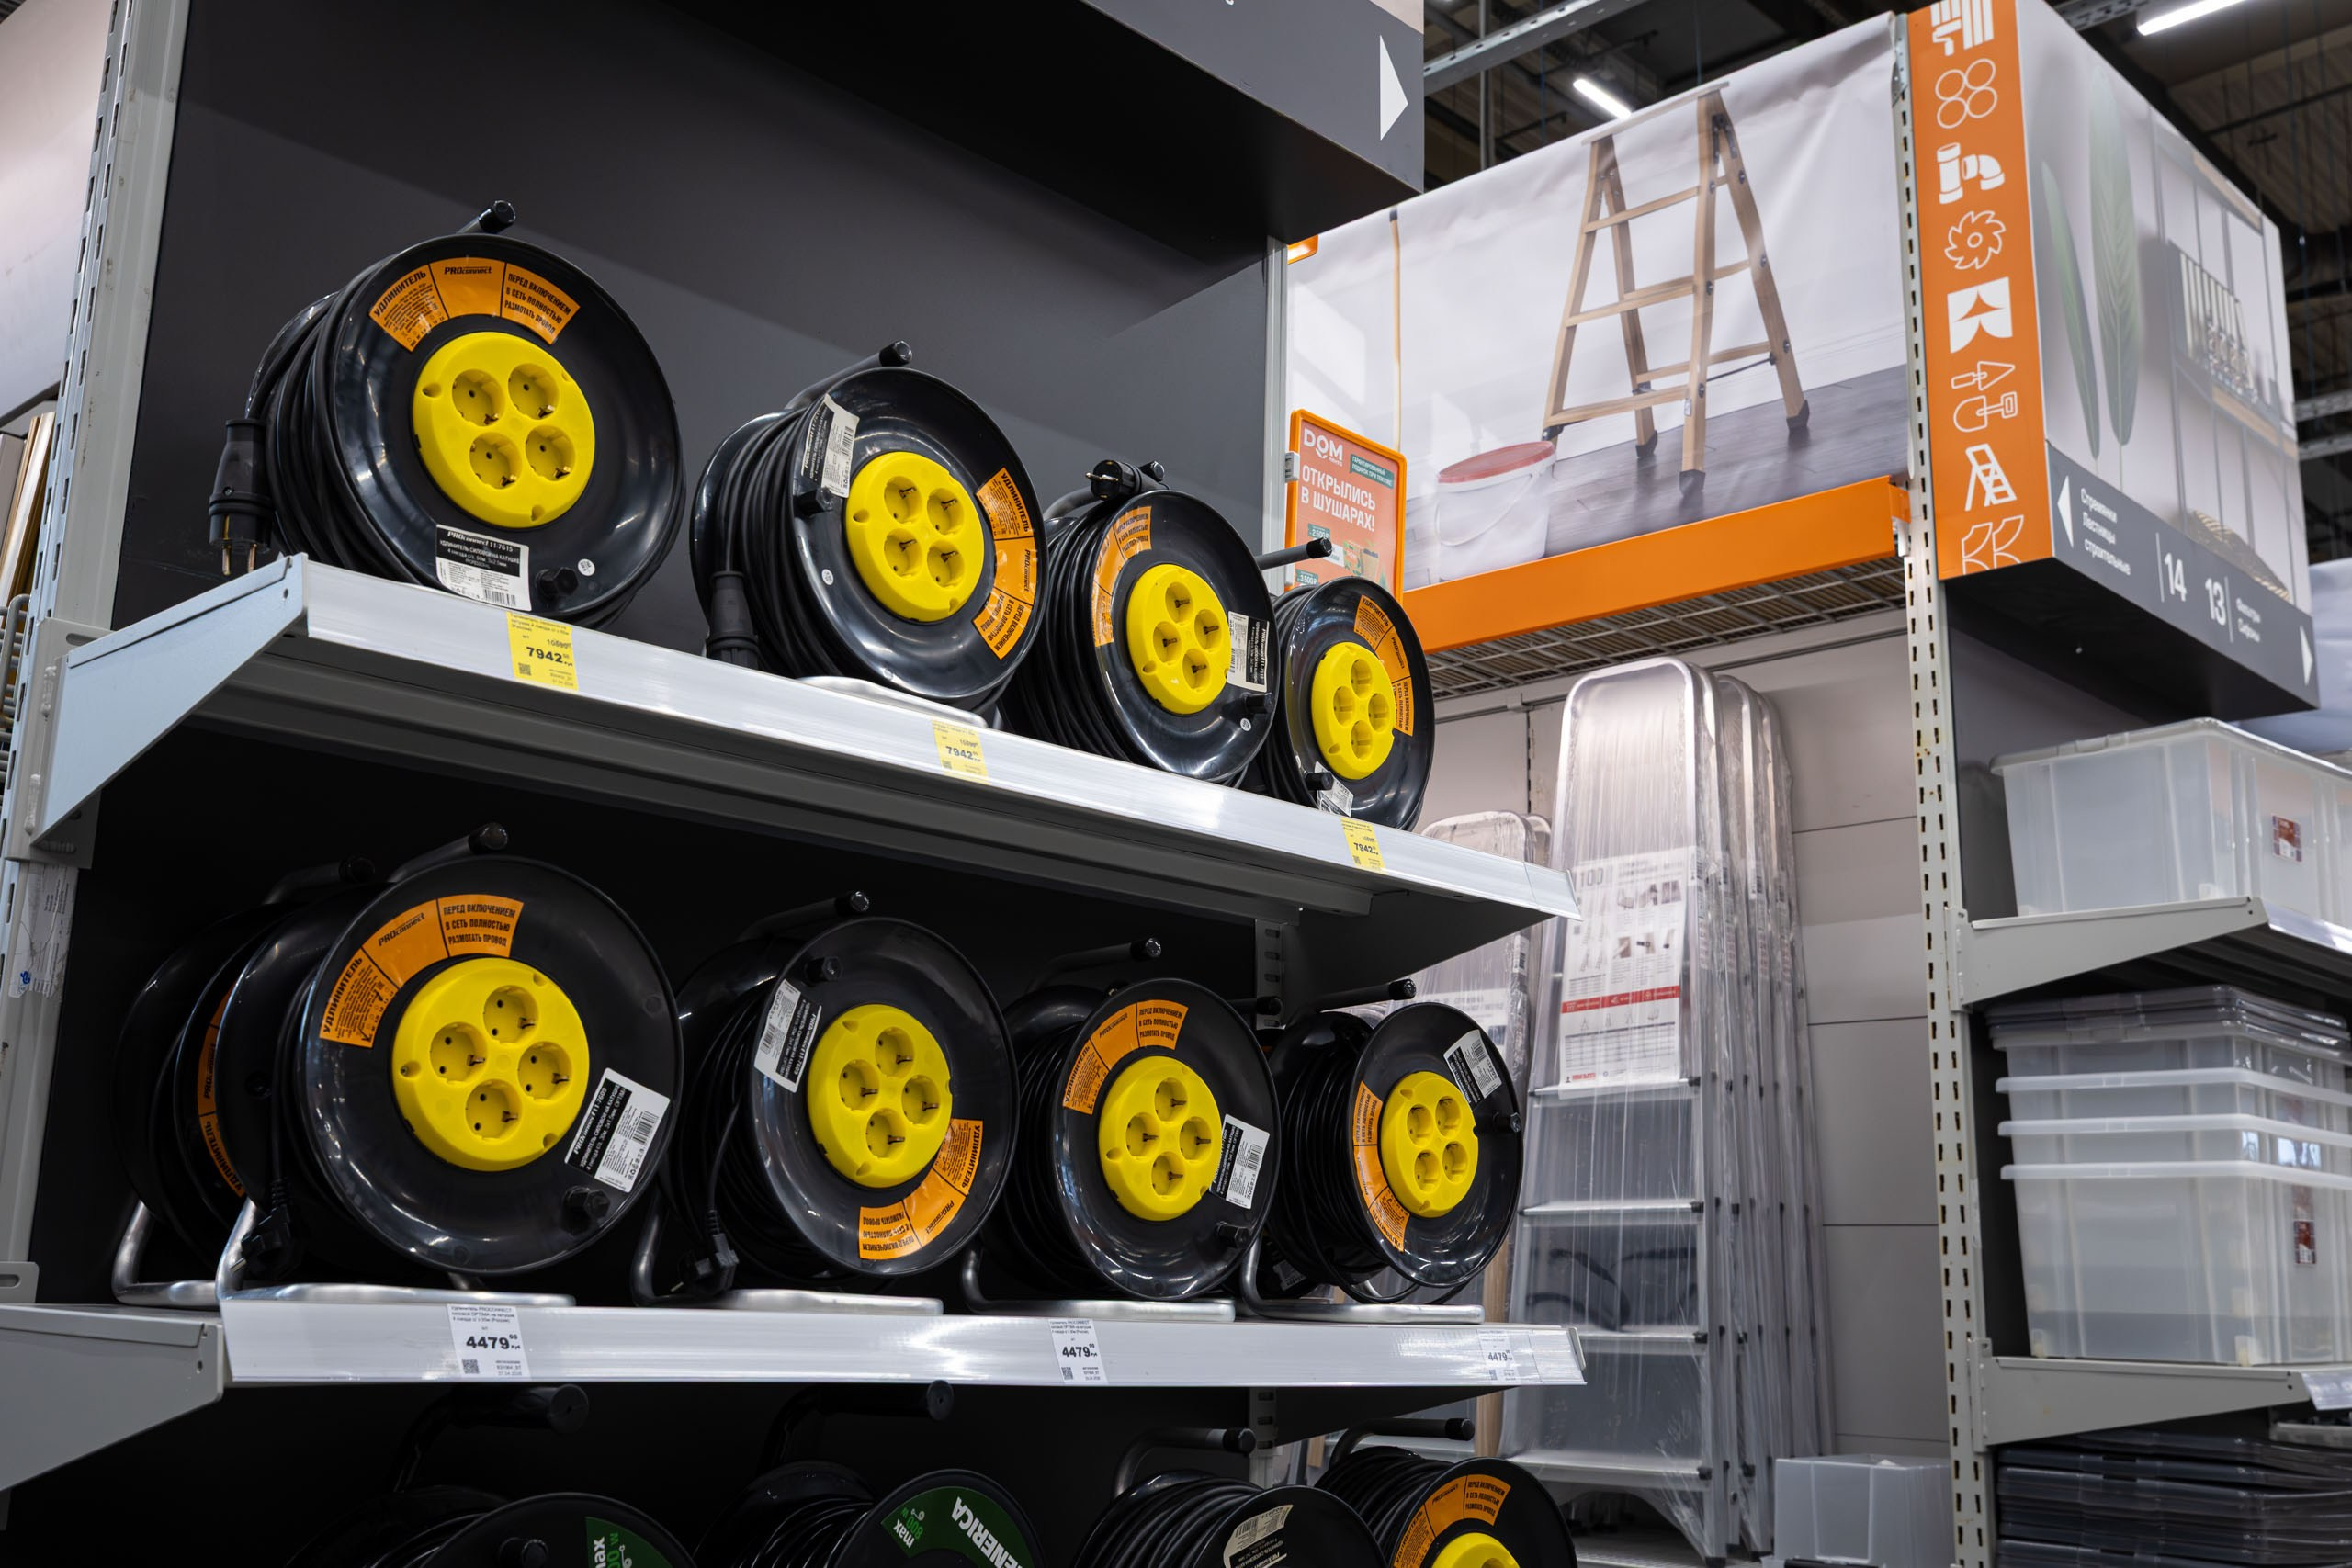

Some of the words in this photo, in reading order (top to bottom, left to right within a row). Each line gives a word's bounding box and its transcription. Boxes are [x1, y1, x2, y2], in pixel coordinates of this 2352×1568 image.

[444, 265, 492, 275] PROconnect
[374, 271, 426, 317] УДЛИНИТЕЛЬ
[508, 273, 528, 289] ПЕРЕД
[528, 281, 571, 316] ВКЛЮЧЕНИЕМ
[511, 288, 526, 301] СЕТЬ
[526, 294, 562, 324] ПОЛНОСТЬЮ
[504, 299, 536, 320] РАЗМОТАТЬ
[536, 311, 556, 334] ПРОВОД
[1001, 473, 1030, 533] УДЛИНИТЕЛЬ
[1302, 465, 1376, 511] ОТКРЫЛИСЬ
[1301, 486, 1310, 504] В
[1313, 491, 1375, 532] ШУШАРАХ!
[2165, 553, 2187, 602] 14
[2205, 577, 2226, 626] 13
[526, 646, 562, 663] 7942
[945, 746, 973, 760] 7942
[1353, 842, 1374, 853] 7942
[443, 904, 465, 915] ПЕРЕД
[467, 903, 516, 918] ВКЛЮЧЕНИЕМ
[451, 920, 468, 929] СЕТЬ
[469, 919, 511, 931] ПОЛНОСТЬЮ
[378, 912, 424, 946] PROconnect
[447, 935, 482, 945] РАЗМОТАТЬ
[482, 936, 507, 946] ПРОВОД
[322, 956, 362, 1033] УДЛИНИТЕЛЬ
[1065, 1045, 1091, 1102] УДЛИНИТЕЛЬ
[572, 1111, 596, 1155] PROconnect
[593, 1087, 608, 1112] 11-7609
[205, 1121, 243, 1192] УДЛИНИТЕЛЬ
[961, 1125, 980, 1188] УДЛИНИТЕЛЬ
[466, 1336, 510, 1349] 4479
[1062, 1347, 1091, 1358] 4479
[1488, 1352, 1508, 1361] 4479
[892, 1518, 915, 1549] max
[905, 1516, 923, 1540] 800
[951, 1496, 1024, 1568] ENERICA
